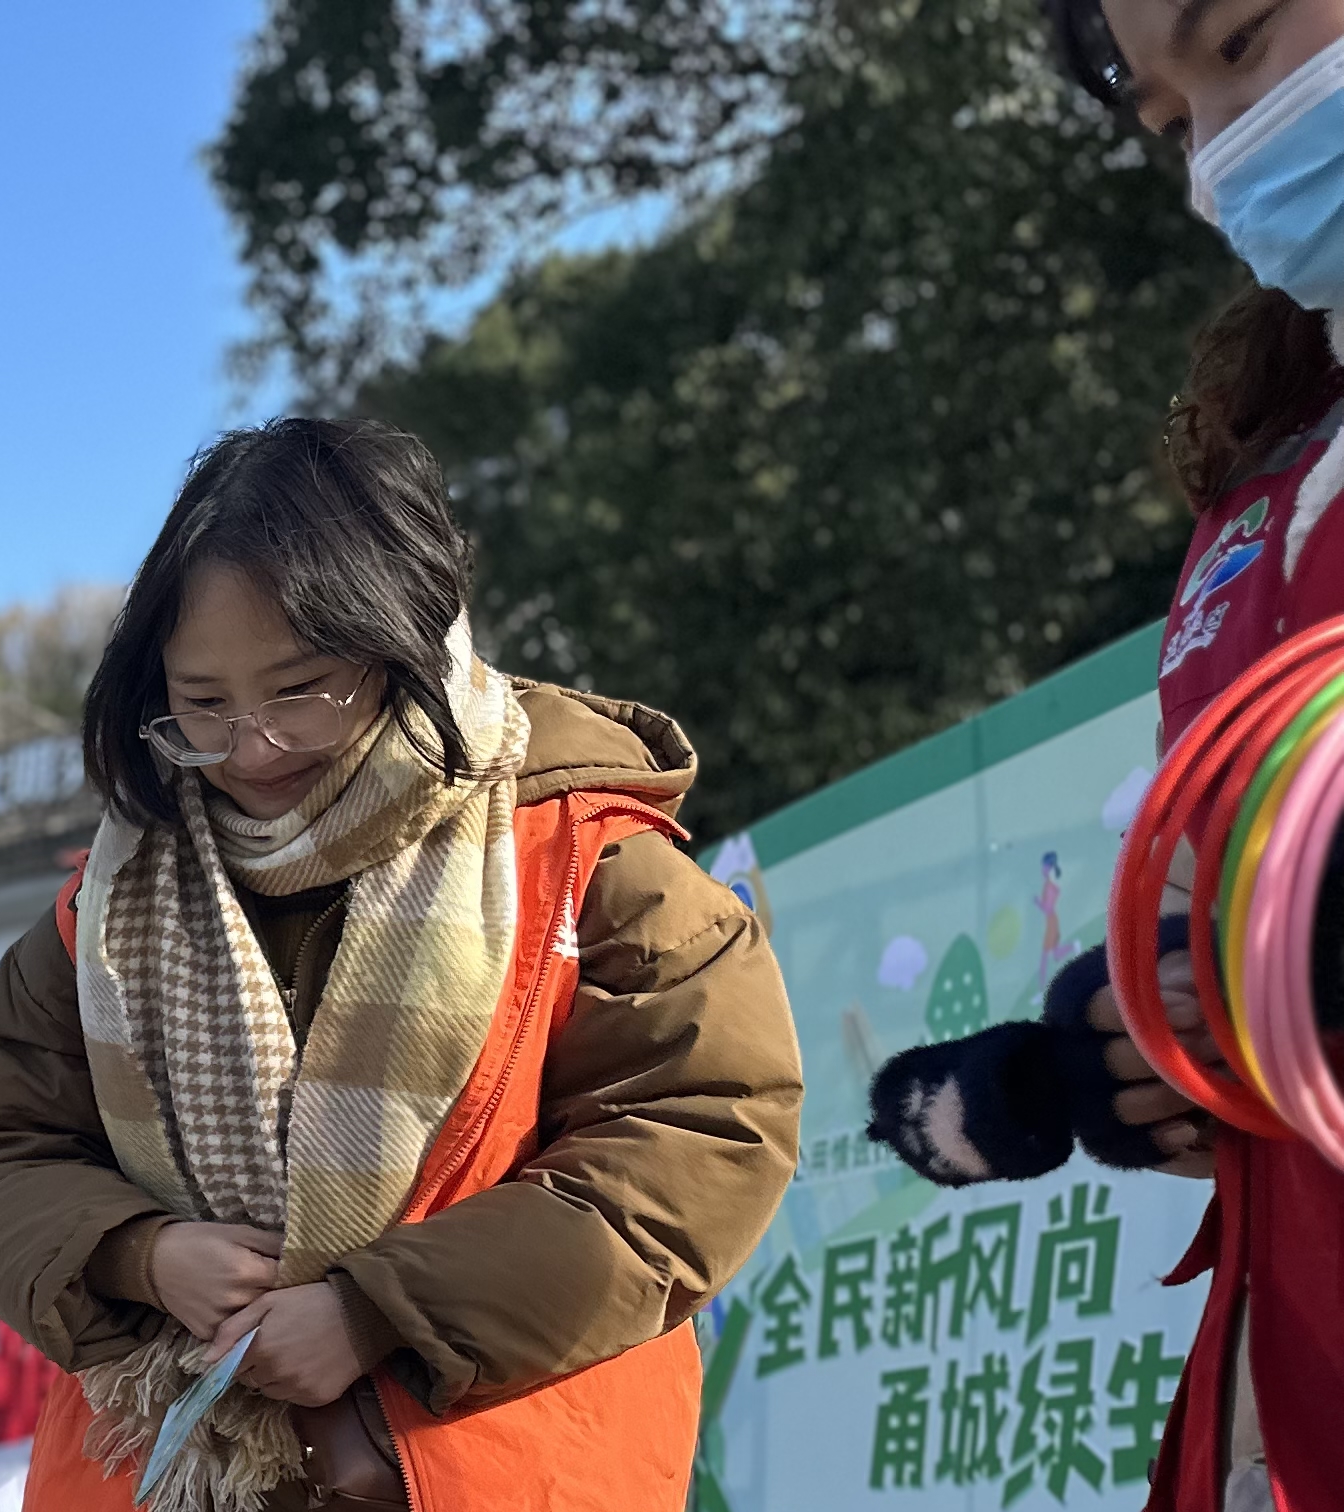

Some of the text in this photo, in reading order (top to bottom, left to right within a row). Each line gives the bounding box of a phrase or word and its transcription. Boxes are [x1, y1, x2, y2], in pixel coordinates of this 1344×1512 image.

[752, 1183, 1121, 1378] 全民新风尚
[868, 1331, 1185, 1508] 甬城绿生
